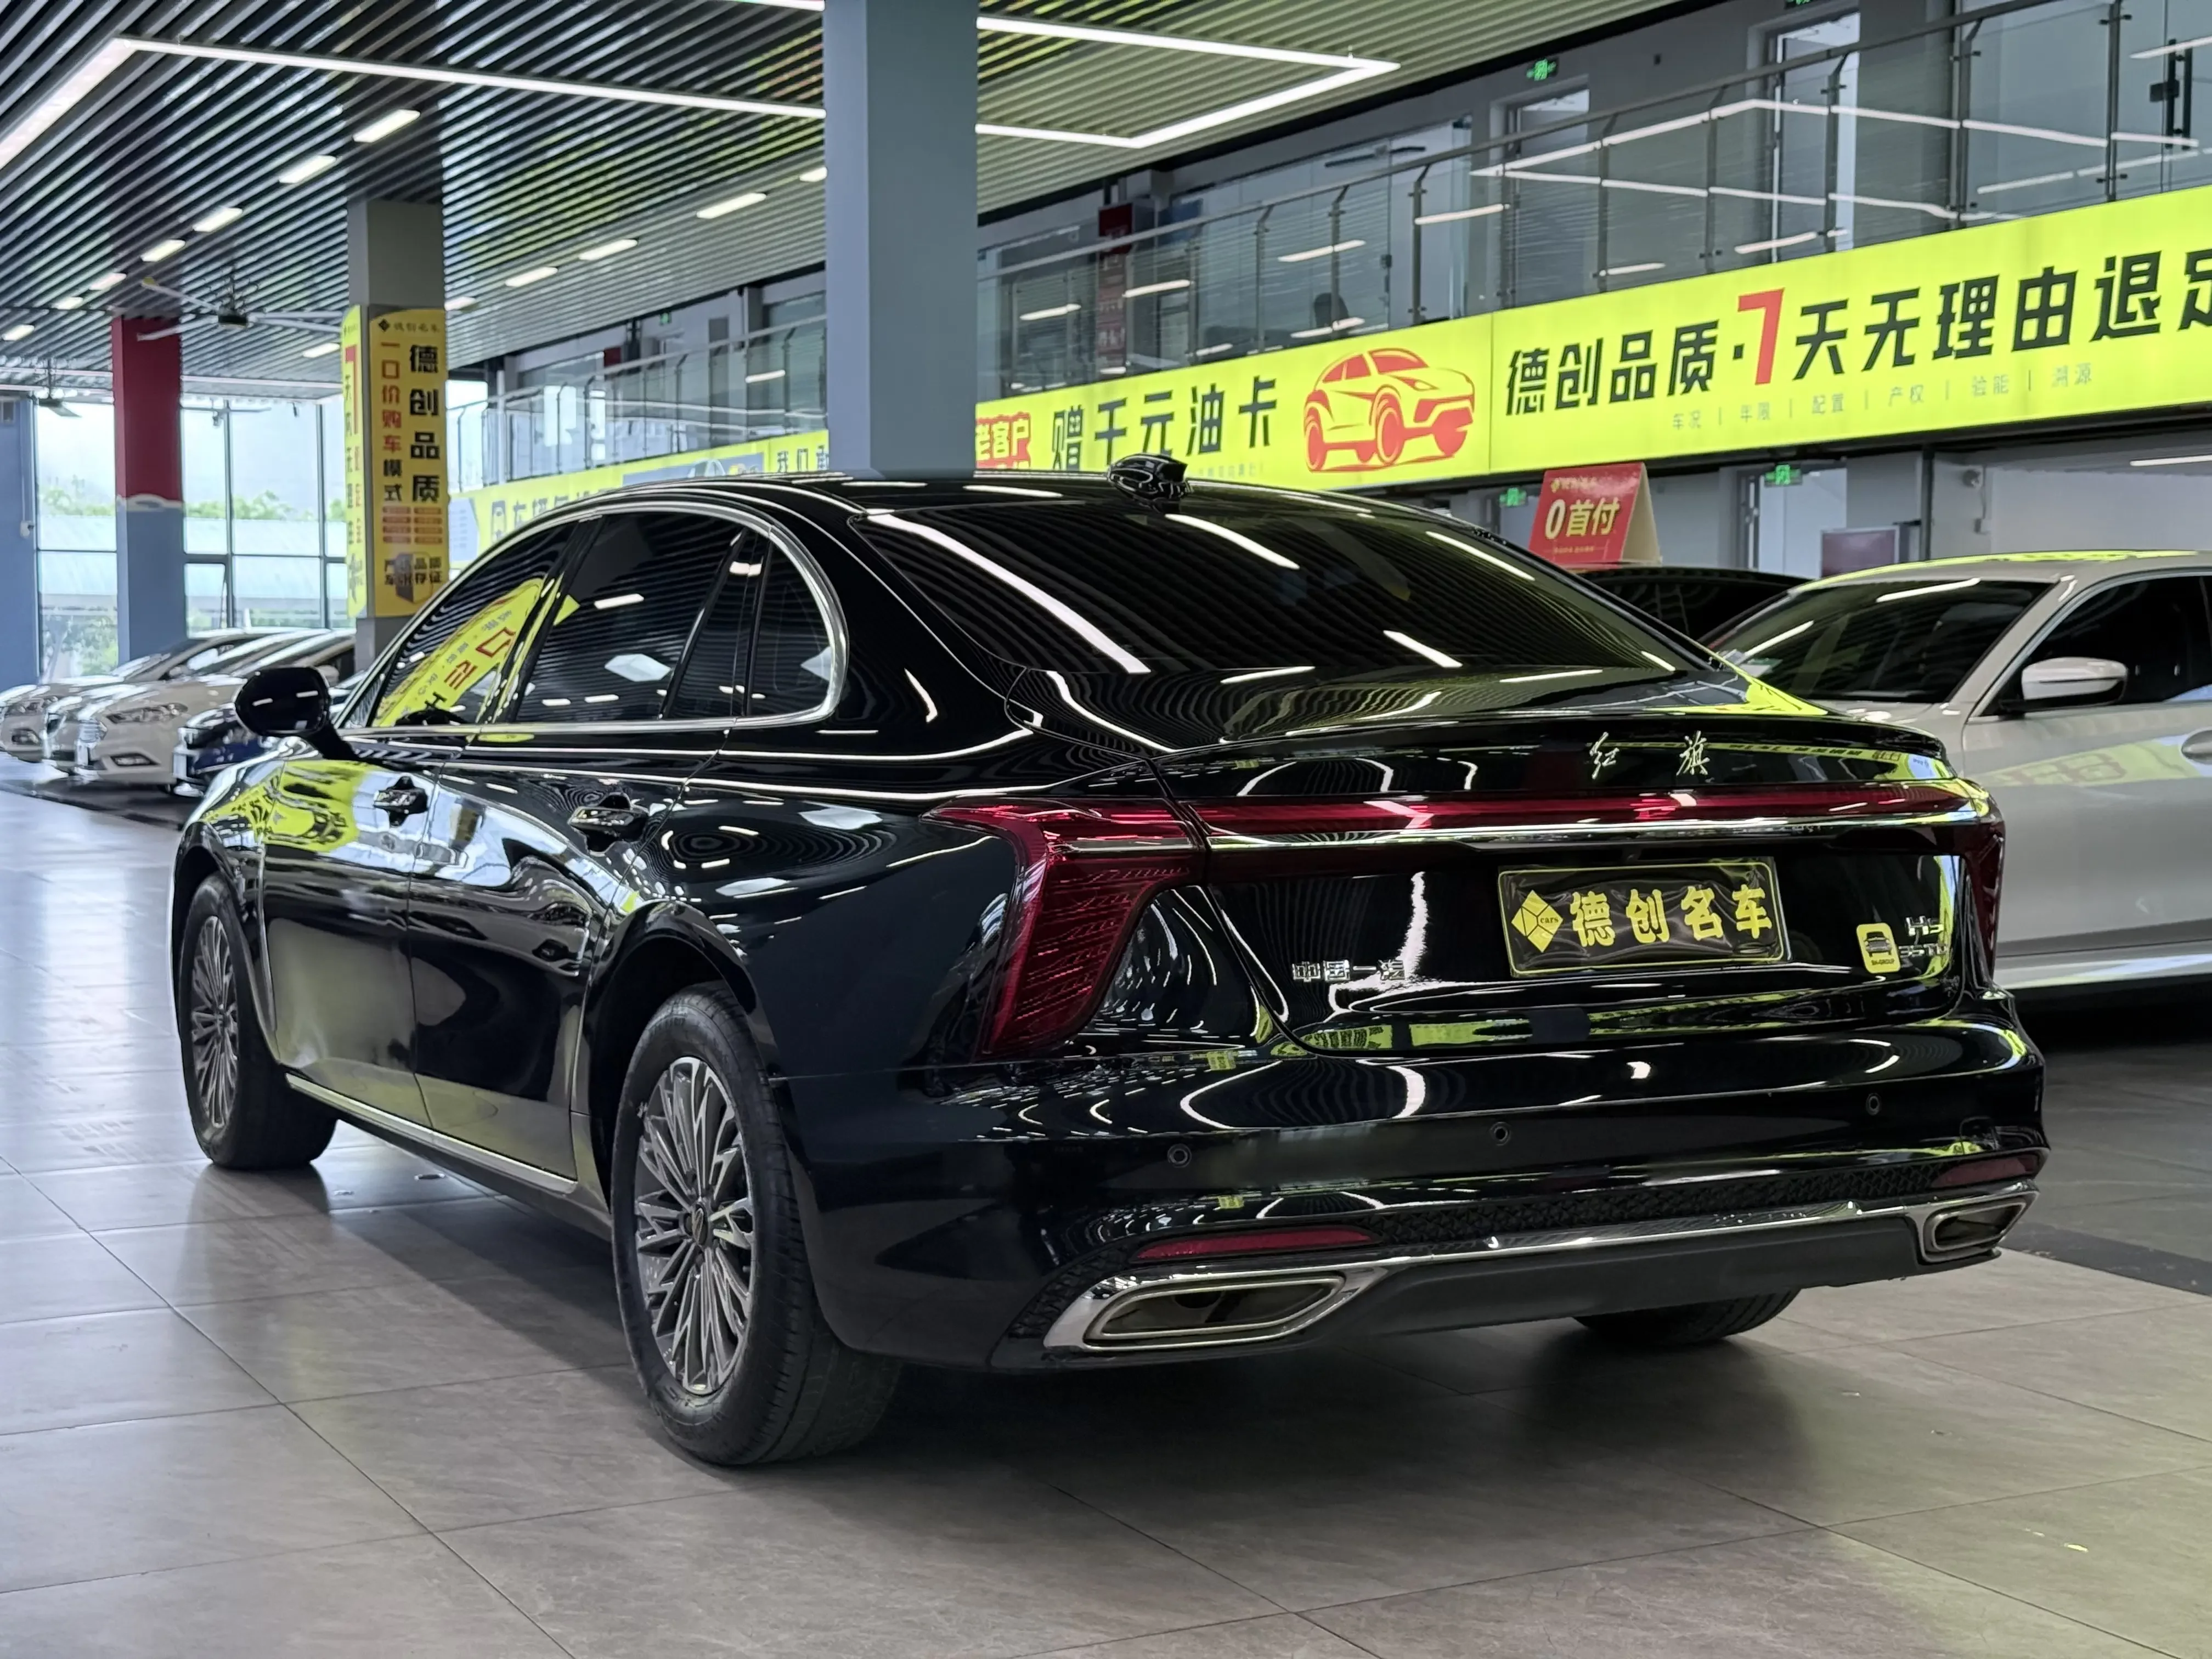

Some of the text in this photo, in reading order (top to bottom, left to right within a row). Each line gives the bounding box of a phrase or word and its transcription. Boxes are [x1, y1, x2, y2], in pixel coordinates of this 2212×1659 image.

[409, 344, 441, 503] 德创品质
[1545, 497, 1620, 540] 0首付
[1589, 730, 1710, 780] 红旗
[1570, 884, 1773, 947] 德创名车
[1291, 959, 1406, 983] 中国一汽
